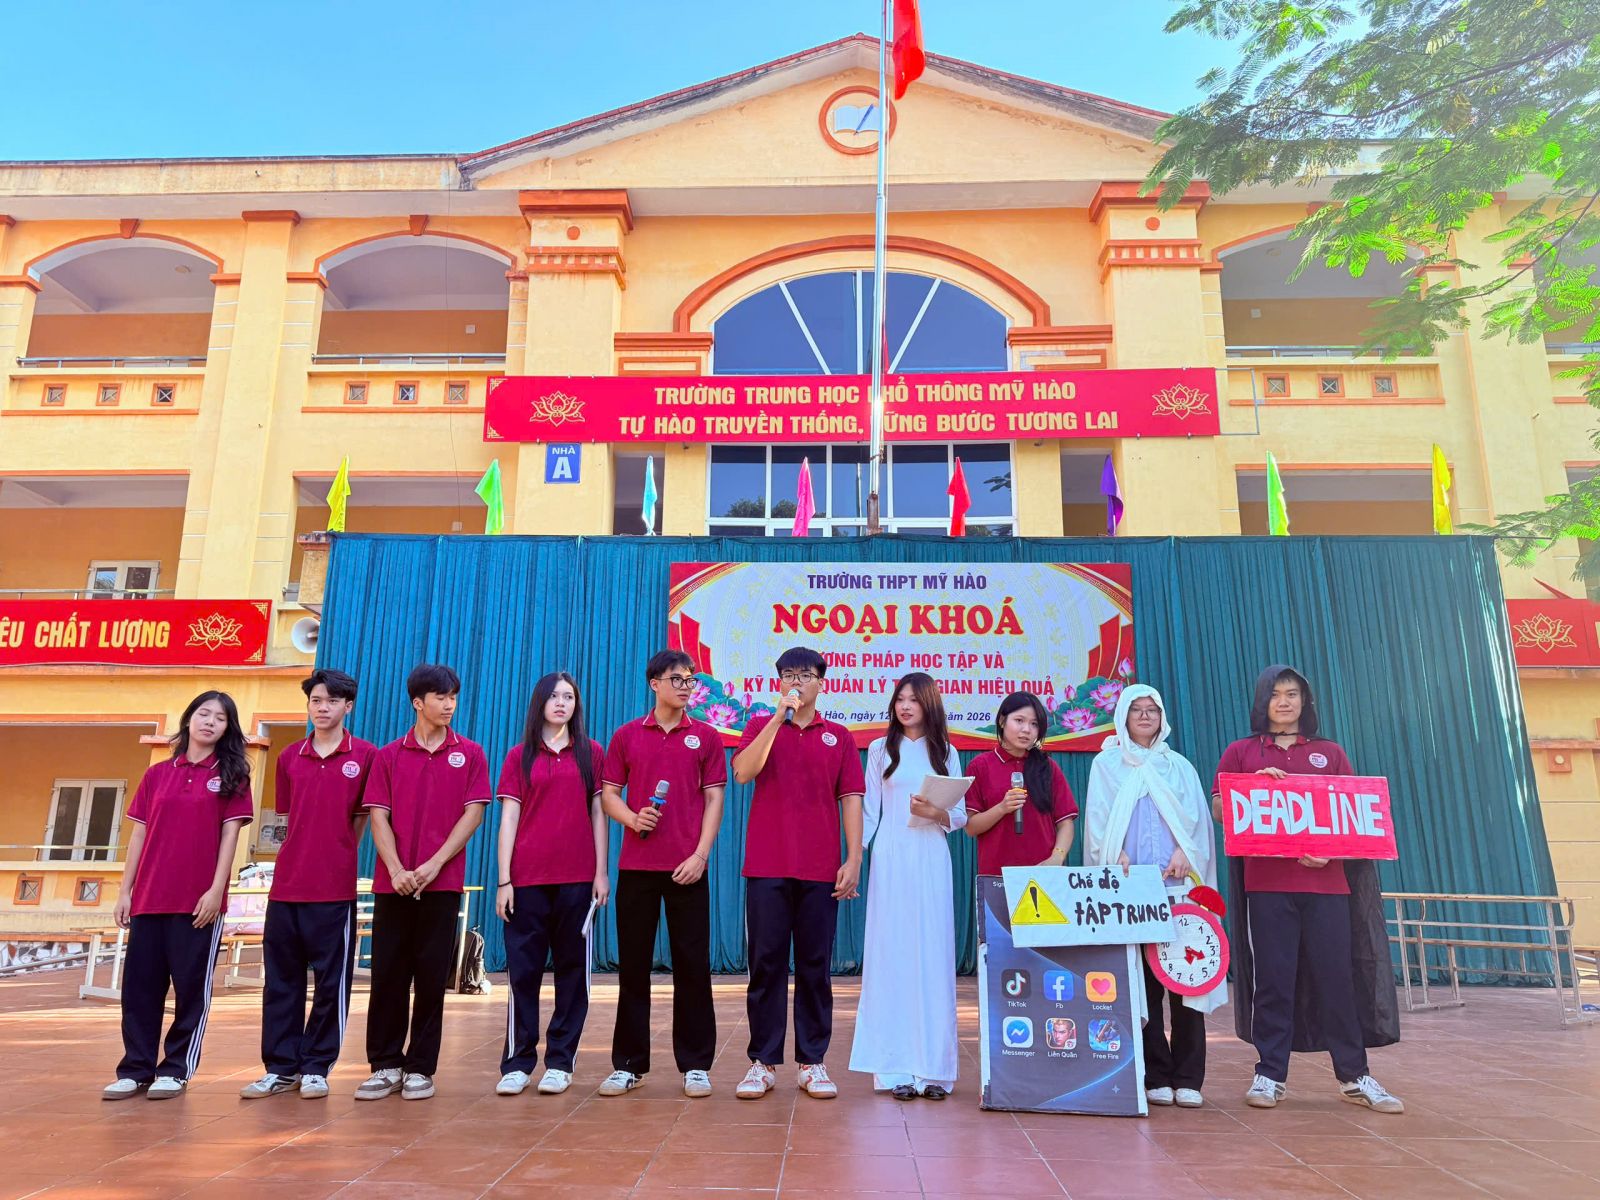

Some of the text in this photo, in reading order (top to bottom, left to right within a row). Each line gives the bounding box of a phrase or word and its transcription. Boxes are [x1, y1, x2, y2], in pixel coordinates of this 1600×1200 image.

[654, 383, 735, 405] TRƯỜNG
[744, 386, 811, 405] TRUNG
[818, 385, 860, 407] HỌC
[915, 380, 983, 402] THÔNG
[989, 379, 1025, 401] MỸ
[1033, 379, 1075, 400] HÀO
[619, 415, 646, 437] TỰ
[654, 413, 696, 434] HÀO
[703, 410, 783, 434] TRUYỀN
[883, 411, 927, 433] ỮNG
[936, 409, 996, 432] BƯỚC
[1006, 411, 1077, 430] TƯƠNG
[1085, 411, 1118, 429] LAI
[552, 445, 576, 455] NHÀ
[552, 456, 573, 479] A
[807, 572, 987, 590] TRƯỜNG THPT MỸ HÀO
[772, 596, 1024, 643] NGOẠI KHOÁ
[34, 612, 91, 648] CHẤT
[99, 617, 171, 653] LƯỢNG
[862, 650, 905, 668] PHÁP
[911, 653, 942, 671] HỌC
[948, 650, 979, 671] TẬP
[984, 651, 1005, 669] VÀ
[744, 674, 764, 692] KỸ
[869, 675, 887, 693] LÝ
[978, 677, 1015, 698] HIỆU
[850, 710, 876, 722] ngày
[967, 712, 991, 721] 2026
[1068, 867, 1120, 893] Chế độ
[1179, 918, 1189, 927] 12
[1206, 935, 1213, 945] 2
[1161, 951, 1168, 961] 9
[1209, 945, 1216, 956] 3
[1168, 963, 1173, 972] 8
[1209, 958, 1215, 967] 4
[1189, 973, 1194, 982] 6
[1201, 967, 1209, 978] 5
[1002, 1049, 1035, 1057] Messenger
